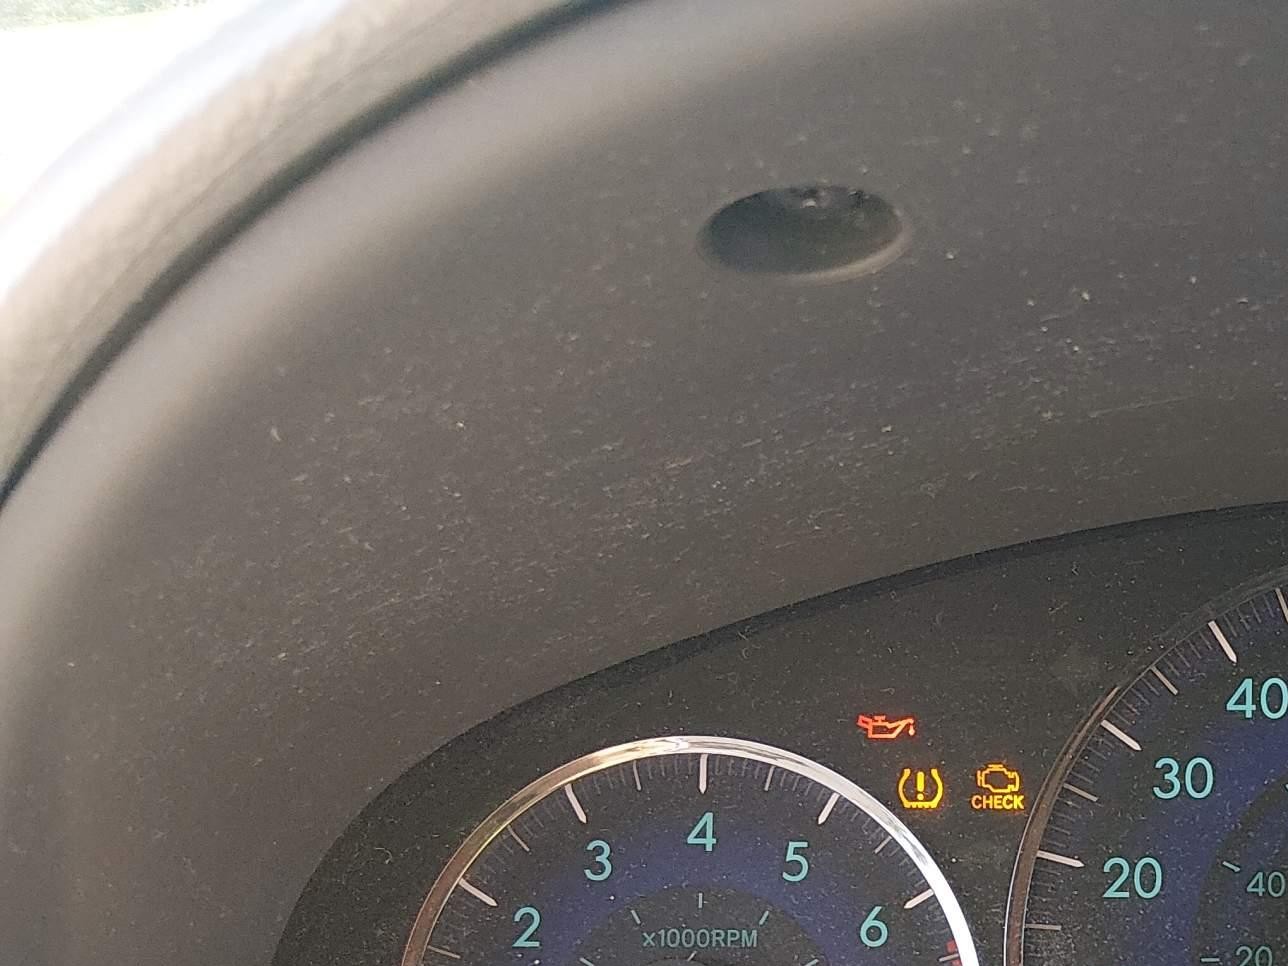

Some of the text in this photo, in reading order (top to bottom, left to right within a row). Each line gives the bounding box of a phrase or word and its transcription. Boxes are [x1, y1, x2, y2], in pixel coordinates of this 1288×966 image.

[1226, 678, 1288, 720] 40
[1154, 757, 1214, 799] 30
[971, 793, 1025, 810] CHECK
[687, 812, 717, 852] 4
[585, 840, 612, 881] 3
[783, 842, 809, 882] 5
[1102, 858, 1162, 900] 20
[1247, 871, 1285, 897] 40
[513, 907, 541, 948] 2
[642, 930, 758, 948] x1000RPM
[860, 906, 888, 947] 6
